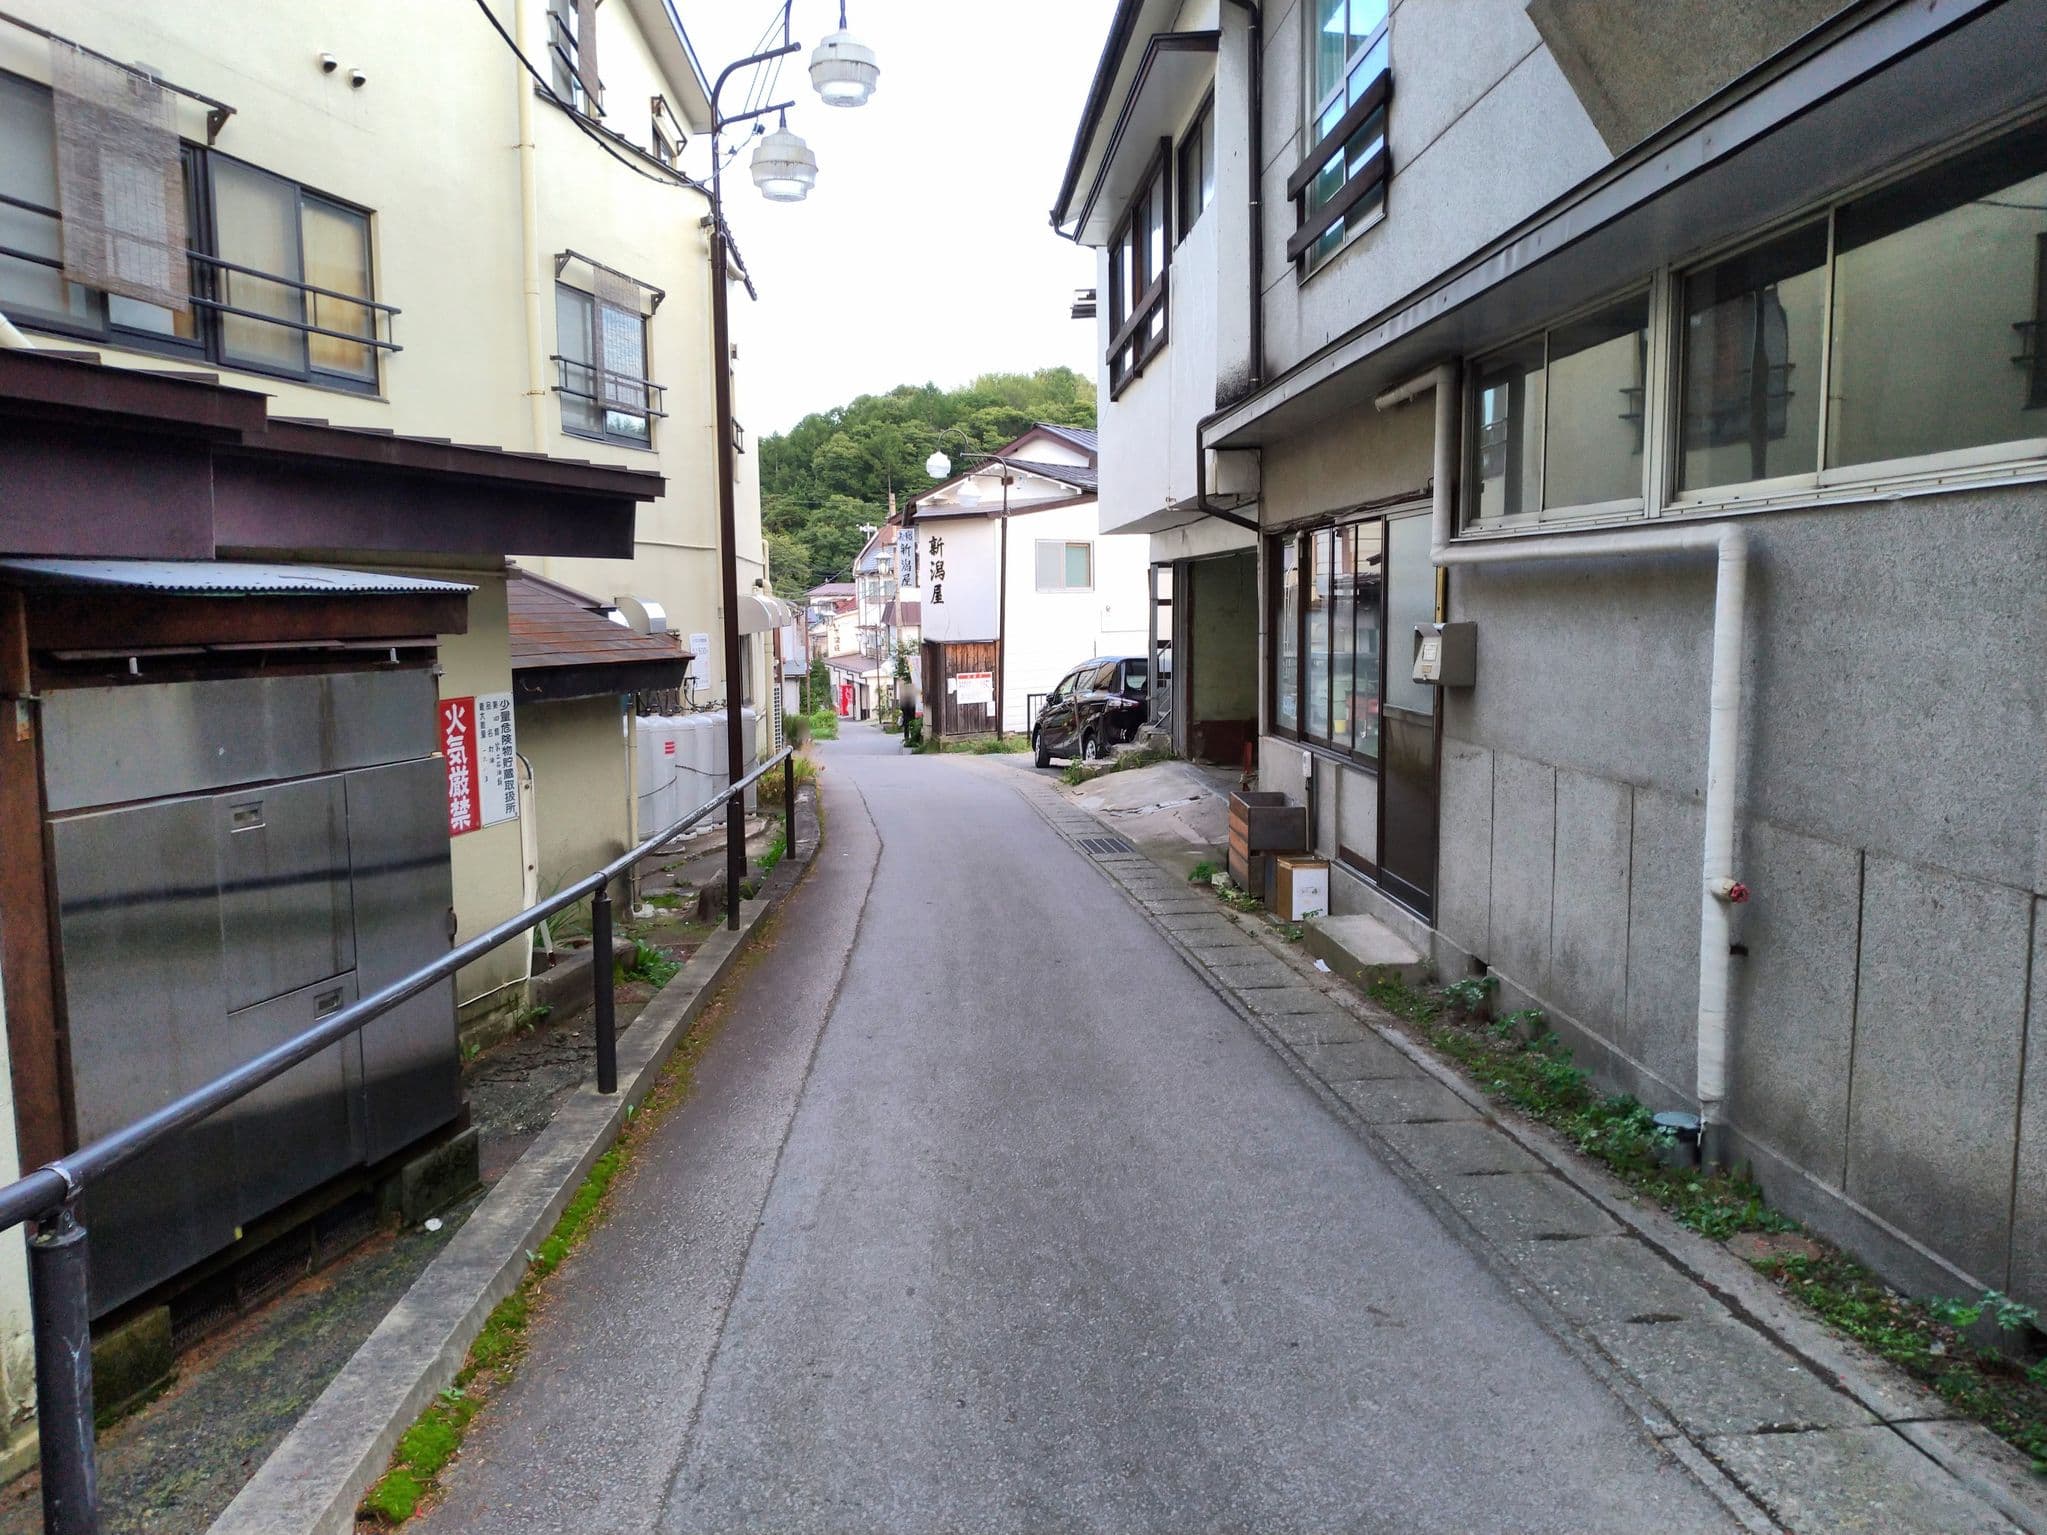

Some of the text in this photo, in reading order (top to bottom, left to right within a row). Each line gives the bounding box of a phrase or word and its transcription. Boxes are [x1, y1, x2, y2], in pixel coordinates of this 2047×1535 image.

[929, 536, 946, 605] 新潟屋
[445, 703, 471, 831] 火気厳禁
[500, 699, 516, 815] 少量危険物貯蔵取扱所
